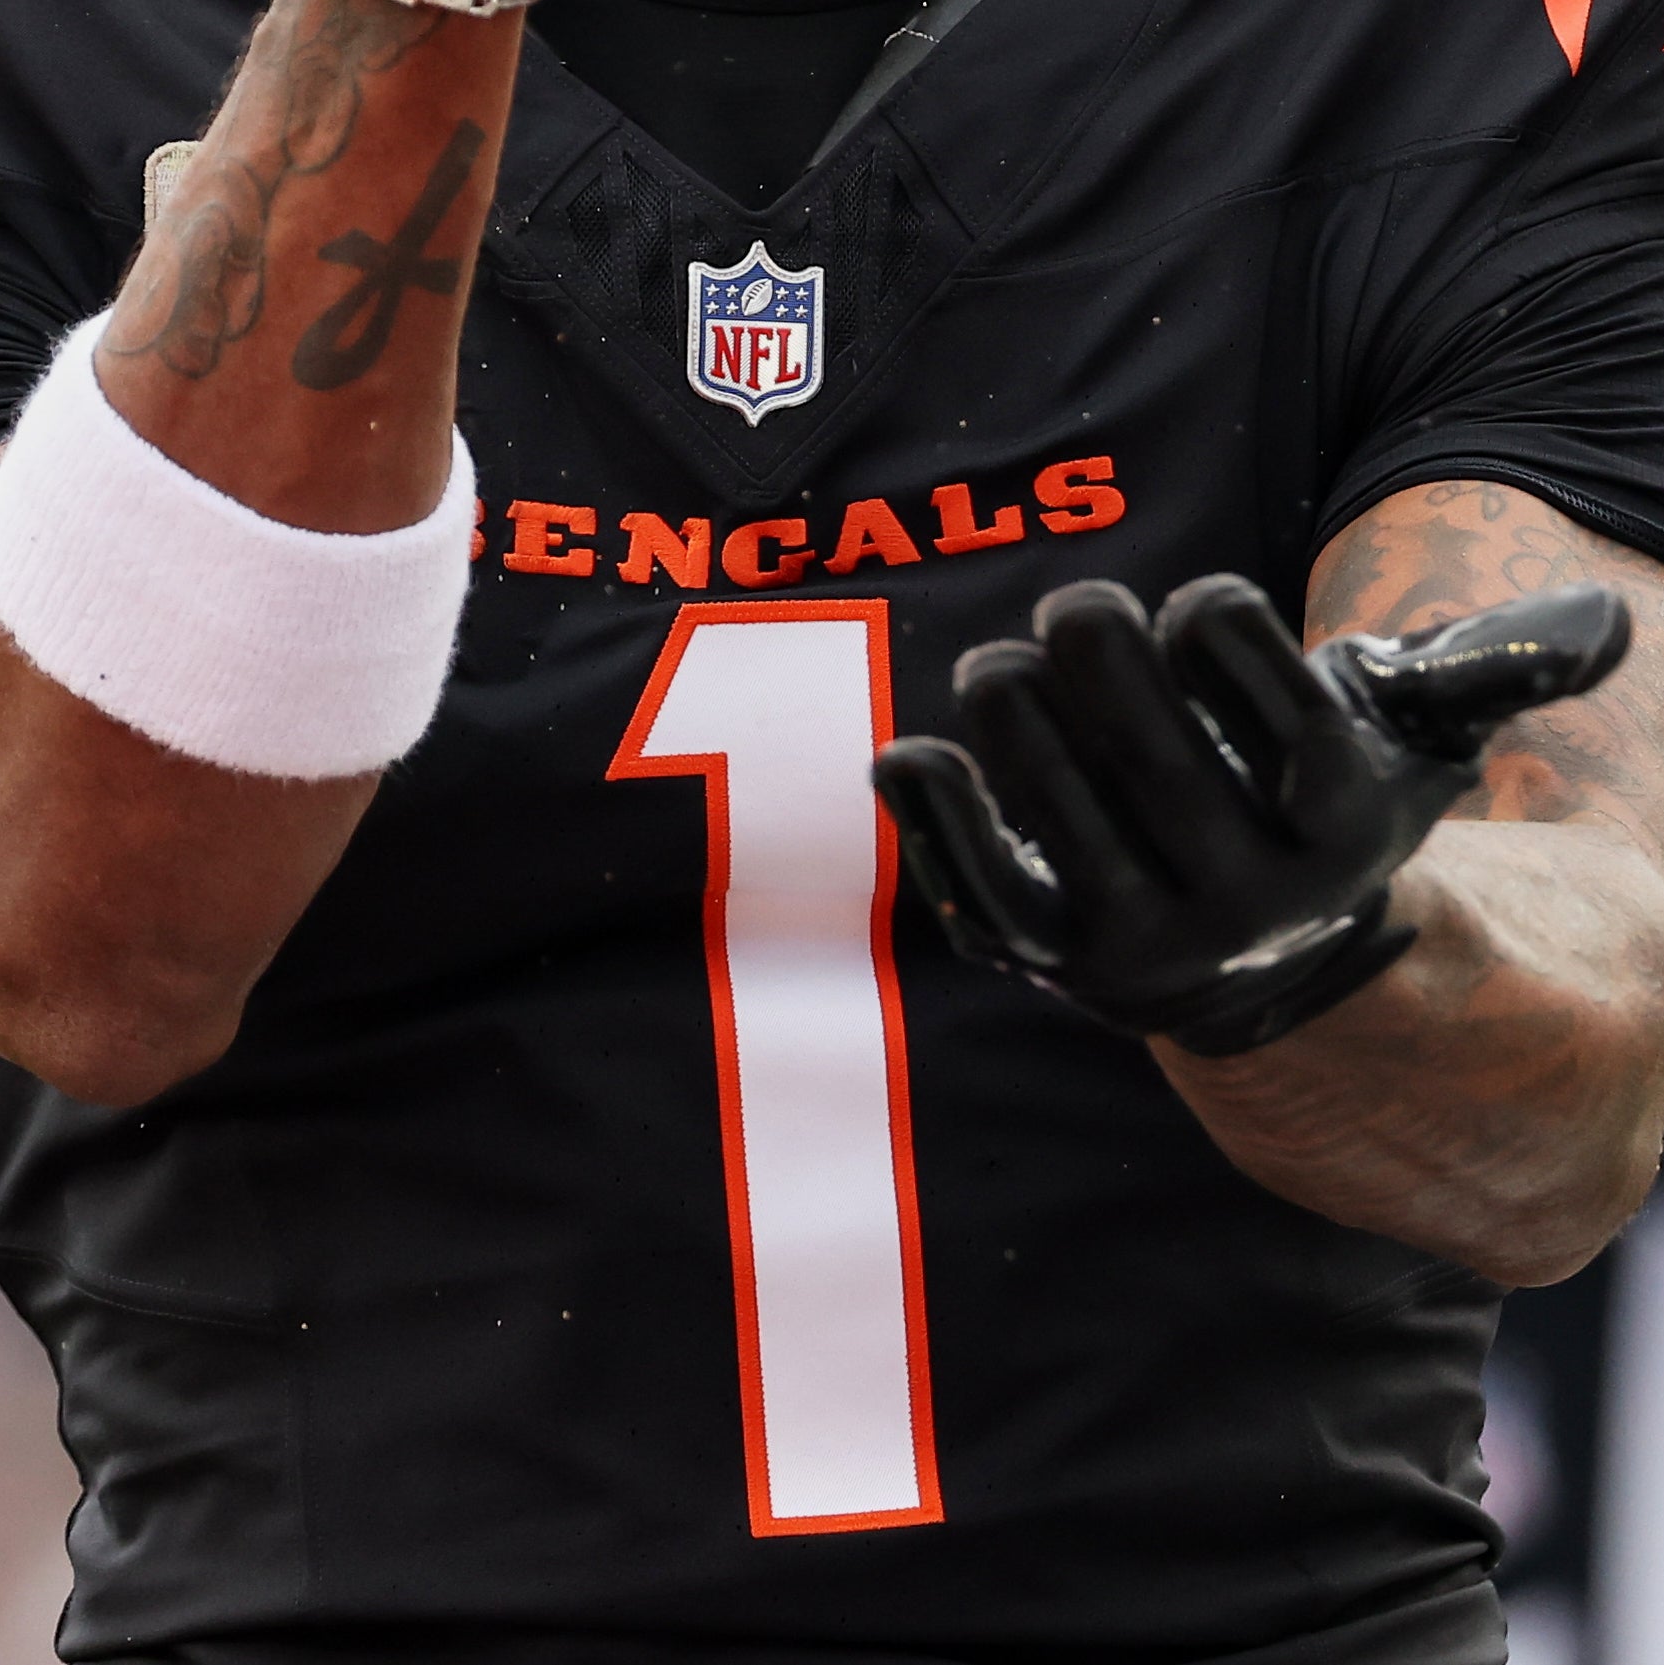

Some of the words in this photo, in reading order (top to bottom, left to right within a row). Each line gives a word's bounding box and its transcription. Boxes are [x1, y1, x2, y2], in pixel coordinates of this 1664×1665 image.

[710, 325, 802, 392] NFL
[468, 455, 1127, 590] ENGALS
[604, 597, 945, 1538] 1
